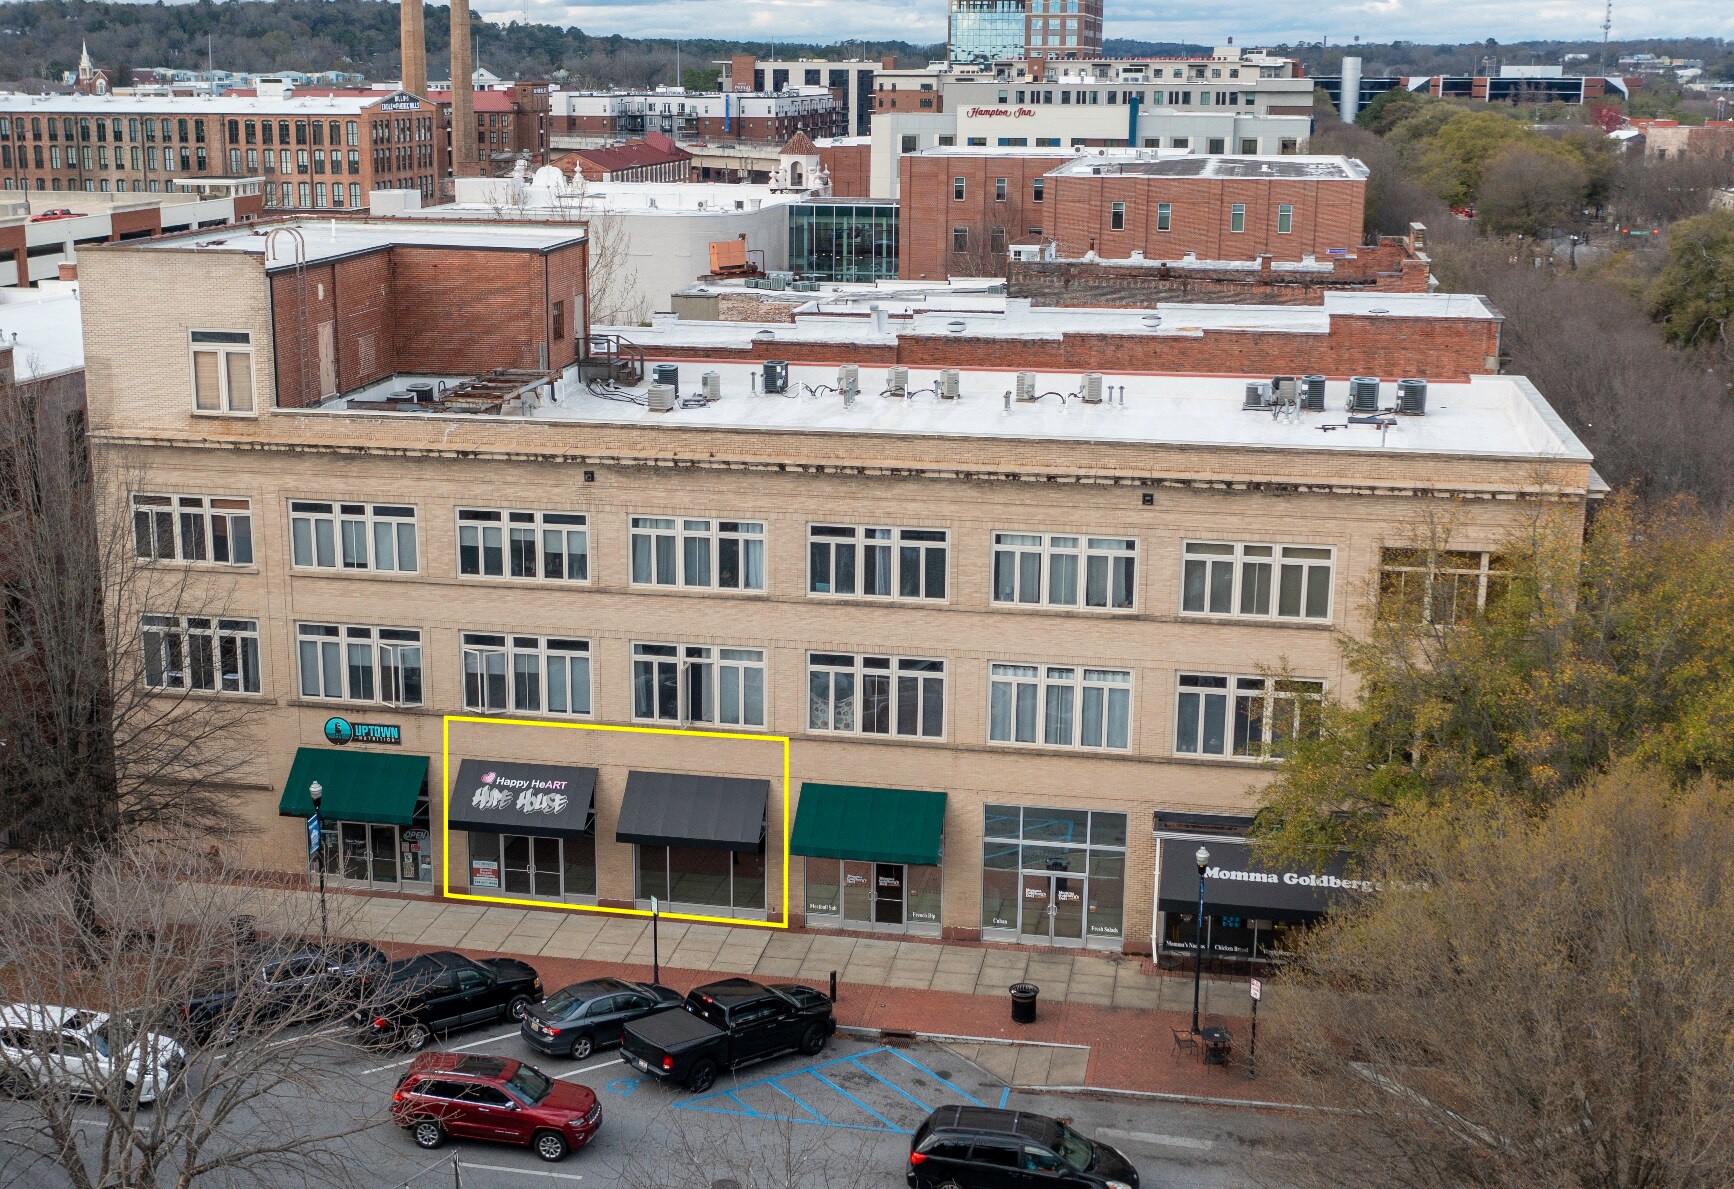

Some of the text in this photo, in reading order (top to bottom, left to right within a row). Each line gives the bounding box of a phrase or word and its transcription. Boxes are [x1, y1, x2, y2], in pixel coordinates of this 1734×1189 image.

[967, 107, 1035, 118] Hampton Inn
[355, 724, 399, 739] UPTOWN
[496, 776, 567, 790] Happy HeART
[516, 788, 568, 814] HOUSE
[403, 831, 427, 840] OPEN
[1204, 866, 1279, 884] Momma
[1188, 941, 1206, 950] Nacos
